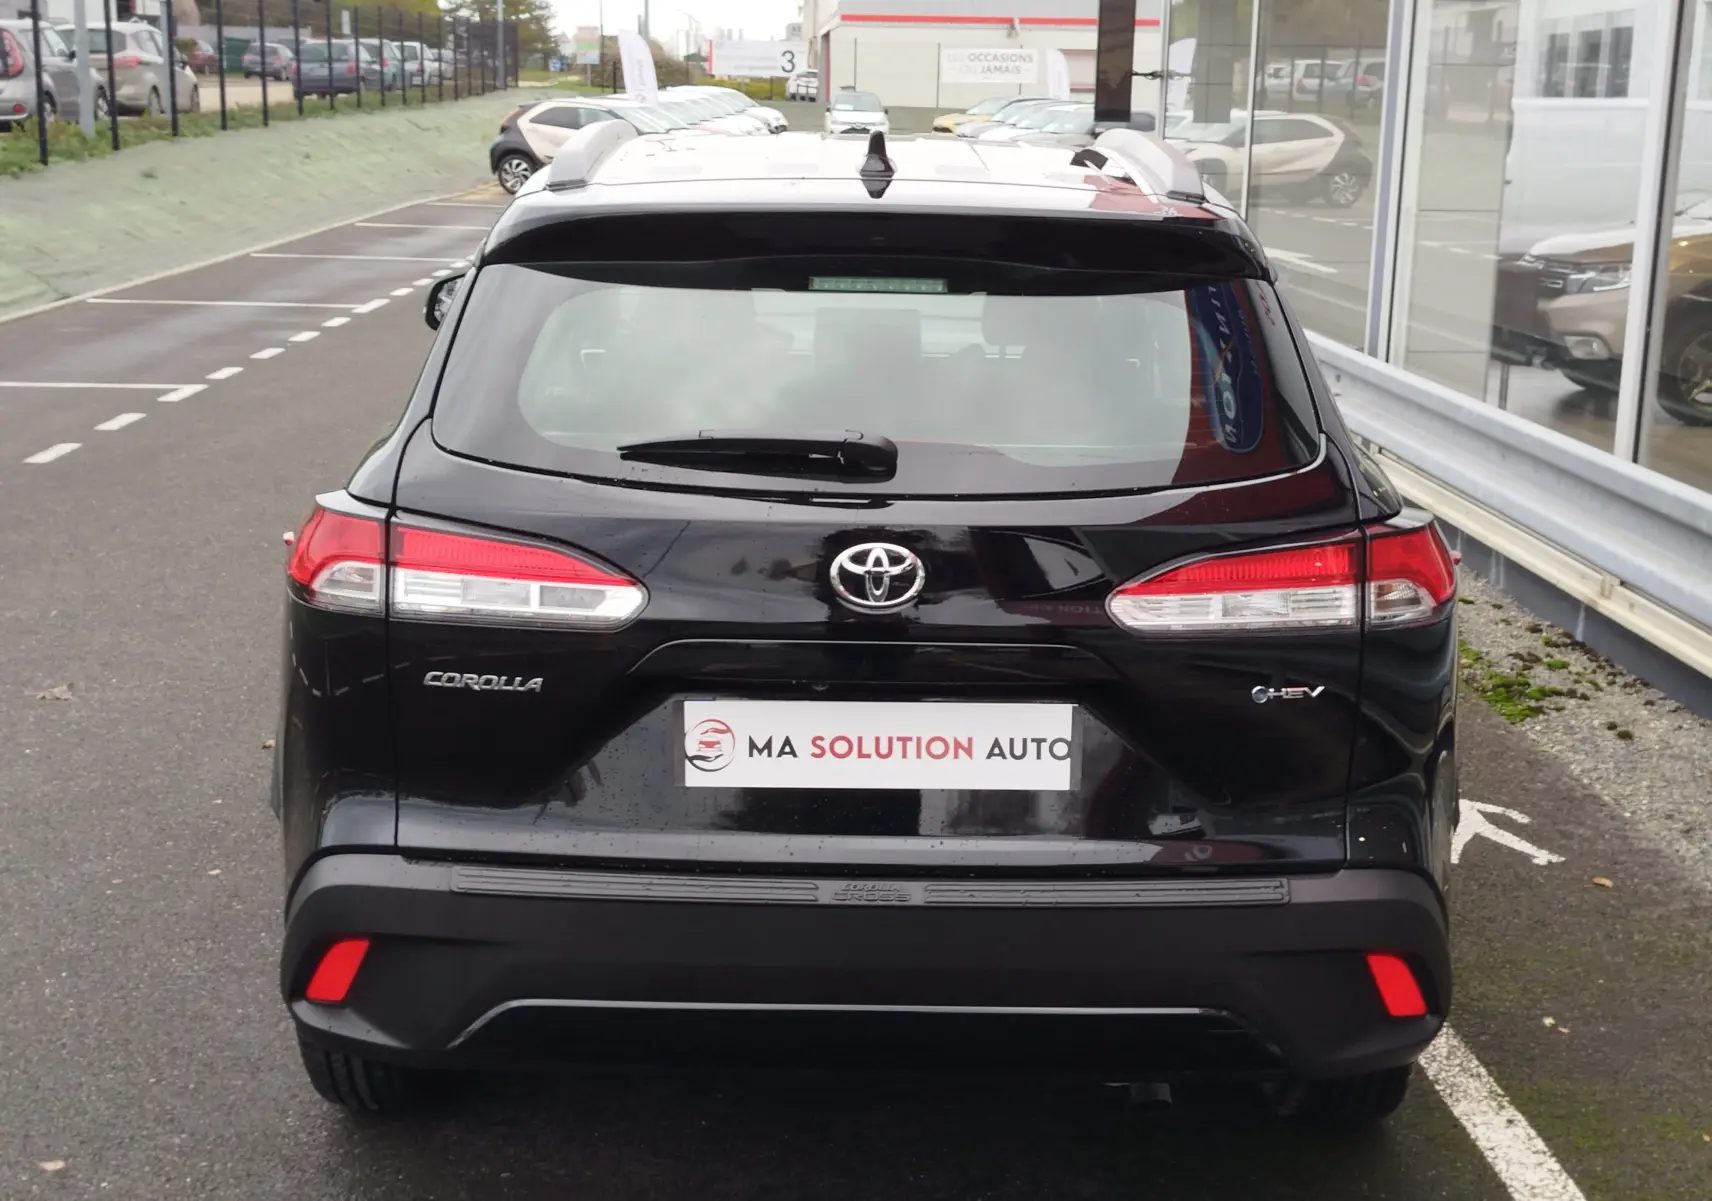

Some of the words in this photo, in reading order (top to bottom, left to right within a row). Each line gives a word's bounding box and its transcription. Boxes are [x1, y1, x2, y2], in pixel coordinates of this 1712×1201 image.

[781, 50, 796, 73] 3
[968, 52, 1034, 63] OCCASIONS
[980, 65, 1021, 74] JAMAIS
[422, 671, 544, 692] COROLLA
[1267, 686, 1325, 699] HEV
[748, 735, 798, 758] MA
[811, 735, 973, 760] SOLUTION
[986, 736, 1072, 761] AUTO
[832, 892, 911, 903] CROSS
